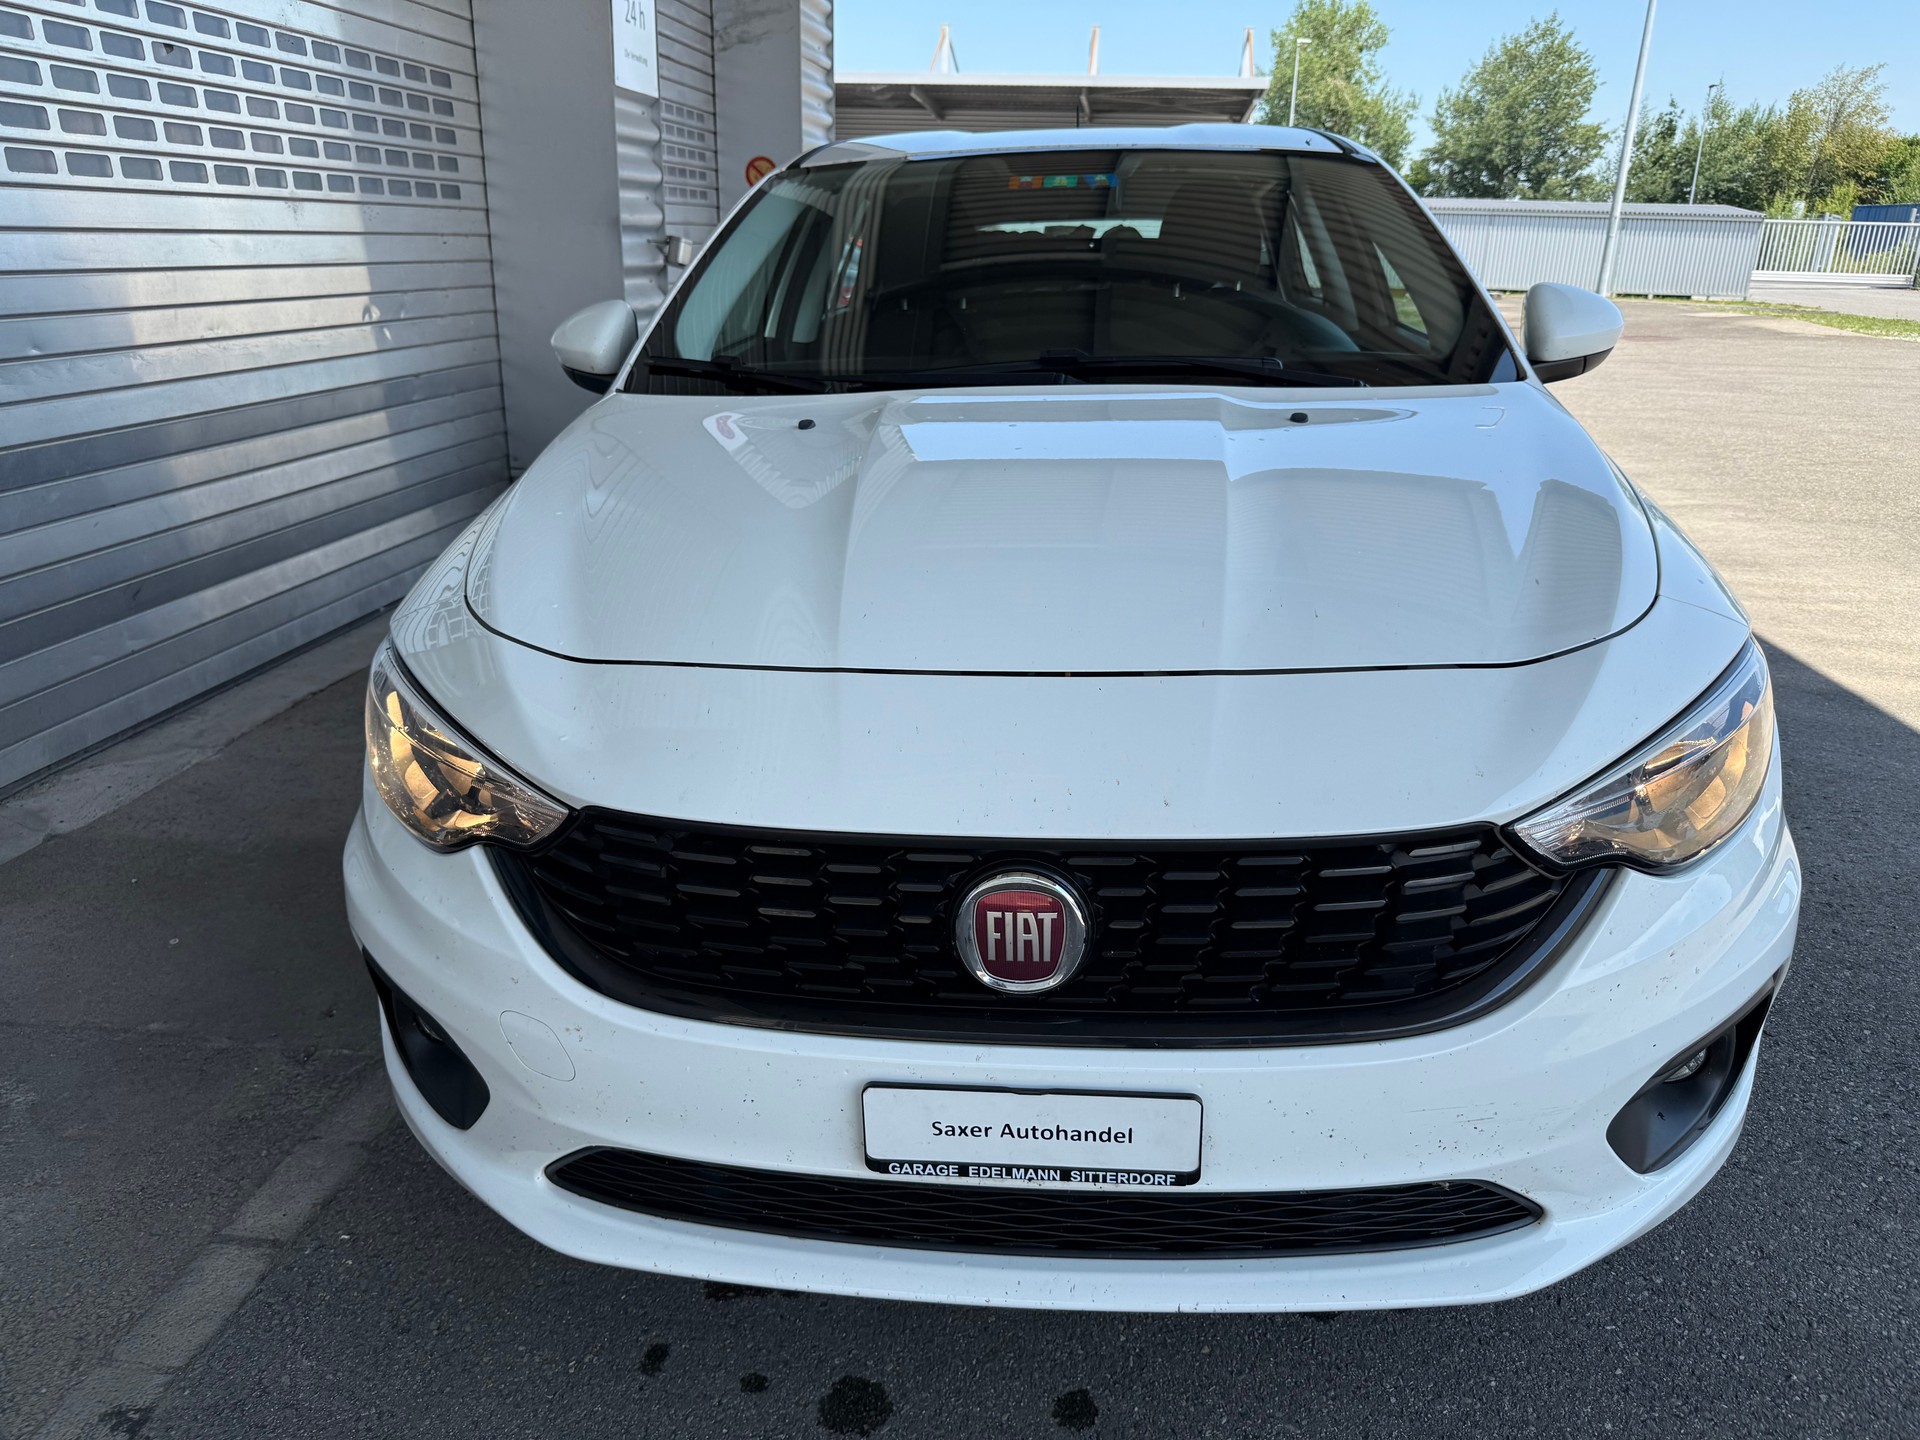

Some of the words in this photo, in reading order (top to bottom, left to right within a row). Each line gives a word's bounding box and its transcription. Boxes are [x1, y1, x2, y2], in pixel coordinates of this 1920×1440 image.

[624, 0, 637, 26] 24
[639, 0, 646, 31] h
[986, 911, 1058, 962] FIAT
[931, 1121, 993, 1138] Saxer
[1000, 1123, 1133, 1144] Autohandel
[888, 1162, 959, 1177] GARAGE
[968, 1165, 1061, 1181] EDELMANN
[1070, 1170, 1177, 1186] SITTERDORF
